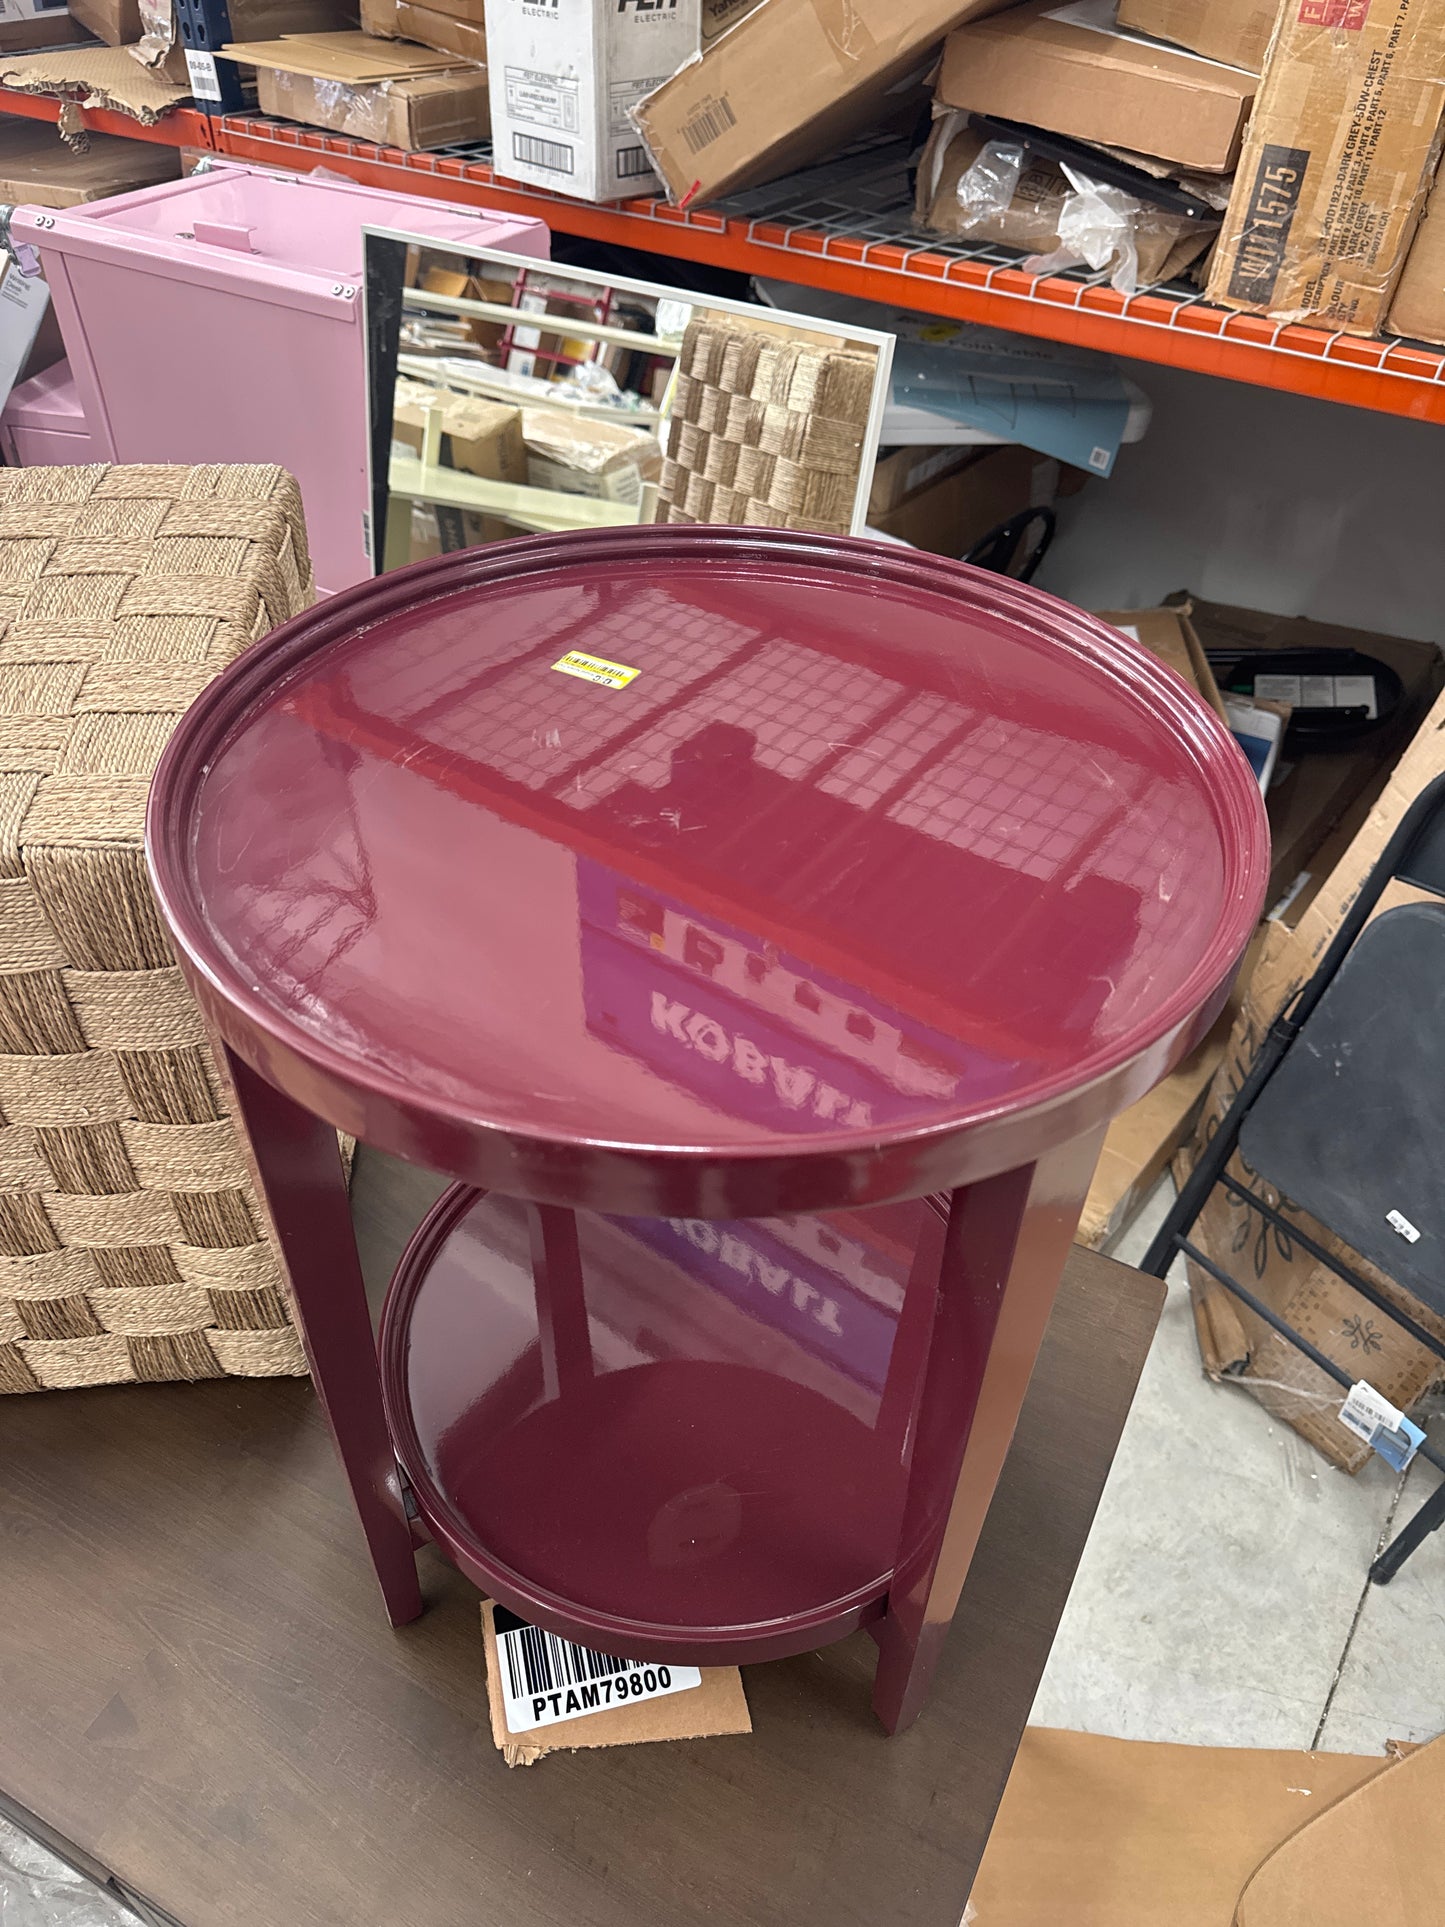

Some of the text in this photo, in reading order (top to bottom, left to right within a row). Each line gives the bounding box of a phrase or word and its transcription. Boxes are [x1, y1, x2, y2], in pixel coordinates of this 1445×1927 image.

[522, 7, 559, 20] ELECTRIC
[634, 12, 676, 23] ELECTRIC
[1327, 233, 1340, 256] PART
[1337, 199, 1350, 225] PART
[1347, 168, 1359, 192] PART
[1356, 133, 1369, 157] PART
[1367, 97, 1380, 122] PART
[1377, 58, 1391, 86] PART
[1388, 21, 1402, 49] PART
[1337, 232, 1349, 257] PART
[1347, 202, 1358, 225] PART
[1357, 162, 1370, 187] PART
[1369, 122, 1383, 147] PART
[1376, 108, 1387, 122] 12
[1238, 165, 1297, 280] WI11575
[1354, 202, 1369, 230] GREY
[532, 1666, 671, 1722] PTAM79800
